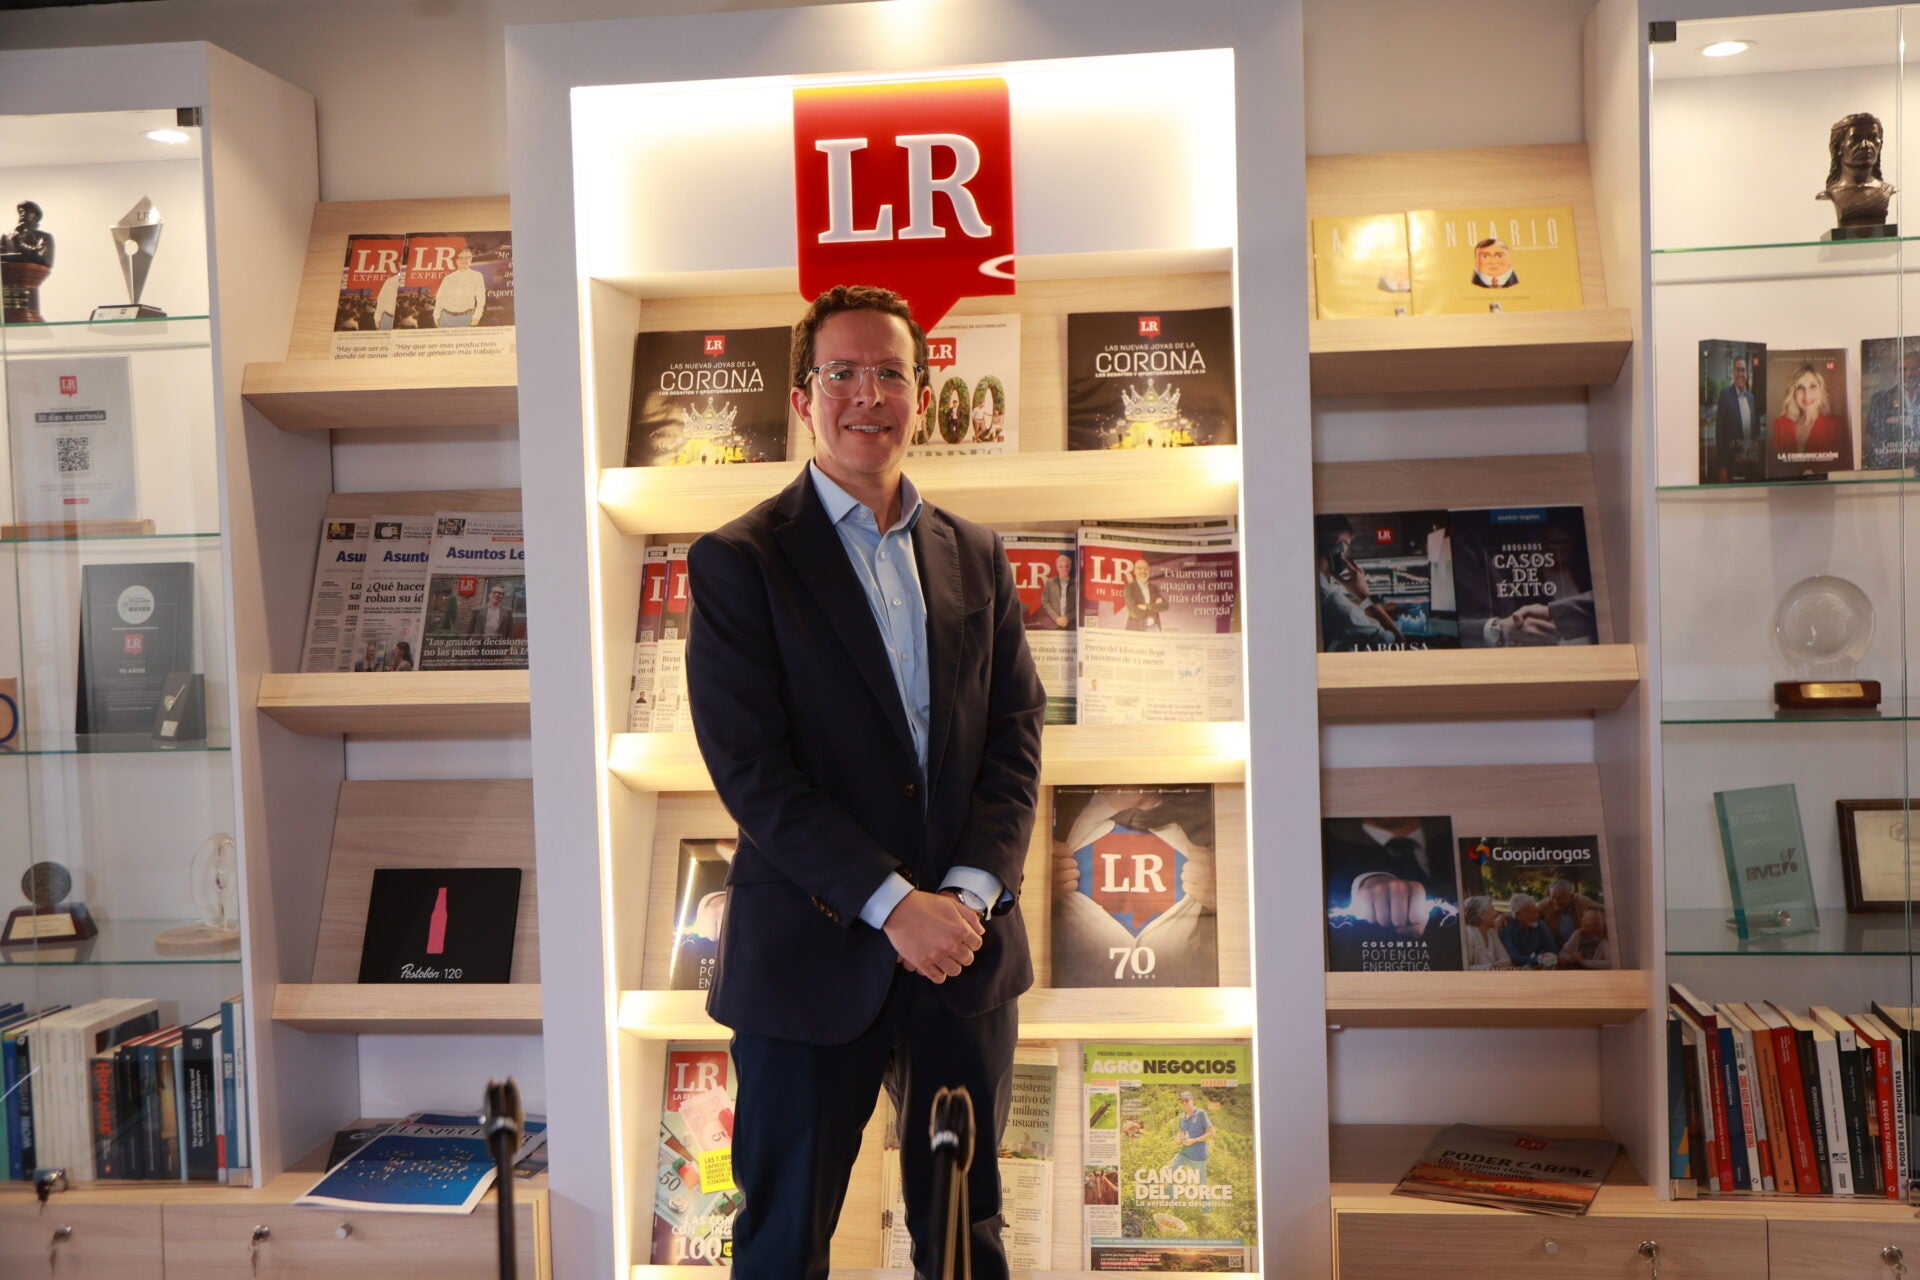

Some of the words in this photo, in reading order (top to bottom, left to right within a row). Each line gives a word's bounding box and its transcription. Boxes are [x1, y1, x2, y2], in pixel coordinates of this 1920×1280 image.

[815, 133, 992, 243] LR
[354, 249, 399, 273] LR
[412, 246, 457, 271] LR
[1141, 321, 1158, 332] LR
[412, 343, 426, 351] que
[440, 341, 455, 349] más
[456, 341, 497, 349] productivos
[706, 340, 723, 351] LR
[928, 344, 953, 359] LR
[394, 350, 416, 358] donde
[427, 350, 456, 358] generan
[685, 362, 712, 370] NUEVAS
[1095, 349, 1206, 373] CORONA
[61, 380, 76, 389] LR
[660, 368, 764, 391] CORONA
[48, 413, 63, 421] días
[75, 412, 104, 421] cortesía
[1377, 530, 1391, 540] LR
[446, 547, 506, 560] Asuntos
[1502, 543, 1543, 551] ABOGADOS
[1494, 553, 1555, 569] CASOS
[1014, 561, 1052, 590] LR
[1090, 555, 1134, 584] LR
[1160, 567, 1218, 579] "Evitaremos
[1222, 569, 1233, 578] un
[1512, 568, 1539, 583] DE
[367, 582, 394, 593] ¿Qué
[459, 579, 474, 590] LR
[1160, 580, 1196, 593] apagón
[1198, 580, 1206, 590] si
[1207, 582, 1234, 591] entra
[1496, 580, 1557, 597] ÉXITO
[366, 593, 396, 603] roban
[398, 595, 410, 603] su
[1096, 588, 1106, 596] IN
[1169, 592, 1190, 603] más
[1192, 592, 1221, 603] oferta
[1223, 593, 1234, 603] de
[1194, 603, 1234, 617] energía"
[125, 638, 142, 649] LR
[425, 638, 445, 646] "Las
[446, 638, 481, 647] grandes
[1107, 645, 1118, 653] del
[437, 647, 450, 656] las
[451, 648, 480, 657] puede
[481, 647, 509, 656] tomar
[510, 647, 518, 656] la
[1492, 847, 1591, 863] Coopidrogas
[1100, 853, 1167, 893] LR
[1745, 863, 1782, 882] BVC
[1362, 949, 1430, 961] POTENCIA
[1109, 946, 1156, 979] 70
[400, 963, 440, 979] Postobón
[443, 968, 463, 979] 120
[673, 1062, 720, 1093] LR
[1894, 1070, 1904, 1113] ENCUESTAS
[1039, 1094, 1051, 1105] de
[1811, 1086, 1821, 1121] PERSEVERANCIA
[1882, 1100, 1889, 1108] EL
[1013, 1105, 1050, 1117] millones
[1882, 1108, 1890, 1121] EGO
[1012, 1118, 1049, 1128] usuarios
[1883, 1121, 1891, 1131] ES
[1896, 1114, 1905, 1130] LAS
[386, 1126, 411, 1135] EL
[1884, 1132, 1892, 1142] TU
[1897, 1130, 1906, 1141] DE
[1816, 1135, 1825, 1154] TRIUNFO
[1885, 1142, 1894, 1170] ENEMIGO
[1898, 1141, 1907, 1167] PODER
[1437, 1157, 1456, 1167] Una
[1458, 1159, 1499, 1172] región
[1502, 1164, 1533, 1176] clave
[1441, 1150, 1512, 1168] PODER
[1515, 1160, 1596, 1179] CARIBE
[1134, 1164, 1200, 1184] CAÑÓN
[1461, 1166, 1473, 1175] la
[1474, 1167, 1534, 1181] economía
[1899, 1167, 1908, 1178] EL
[658, 1170, 682, 1192] 50
[1135, 1184, 1170, 1200] DEL
[1173, 1184, 1233, 1200] PORCE
[671, 1225, 697, 1235] CON
[673, 1237, 722, 1260] 100
